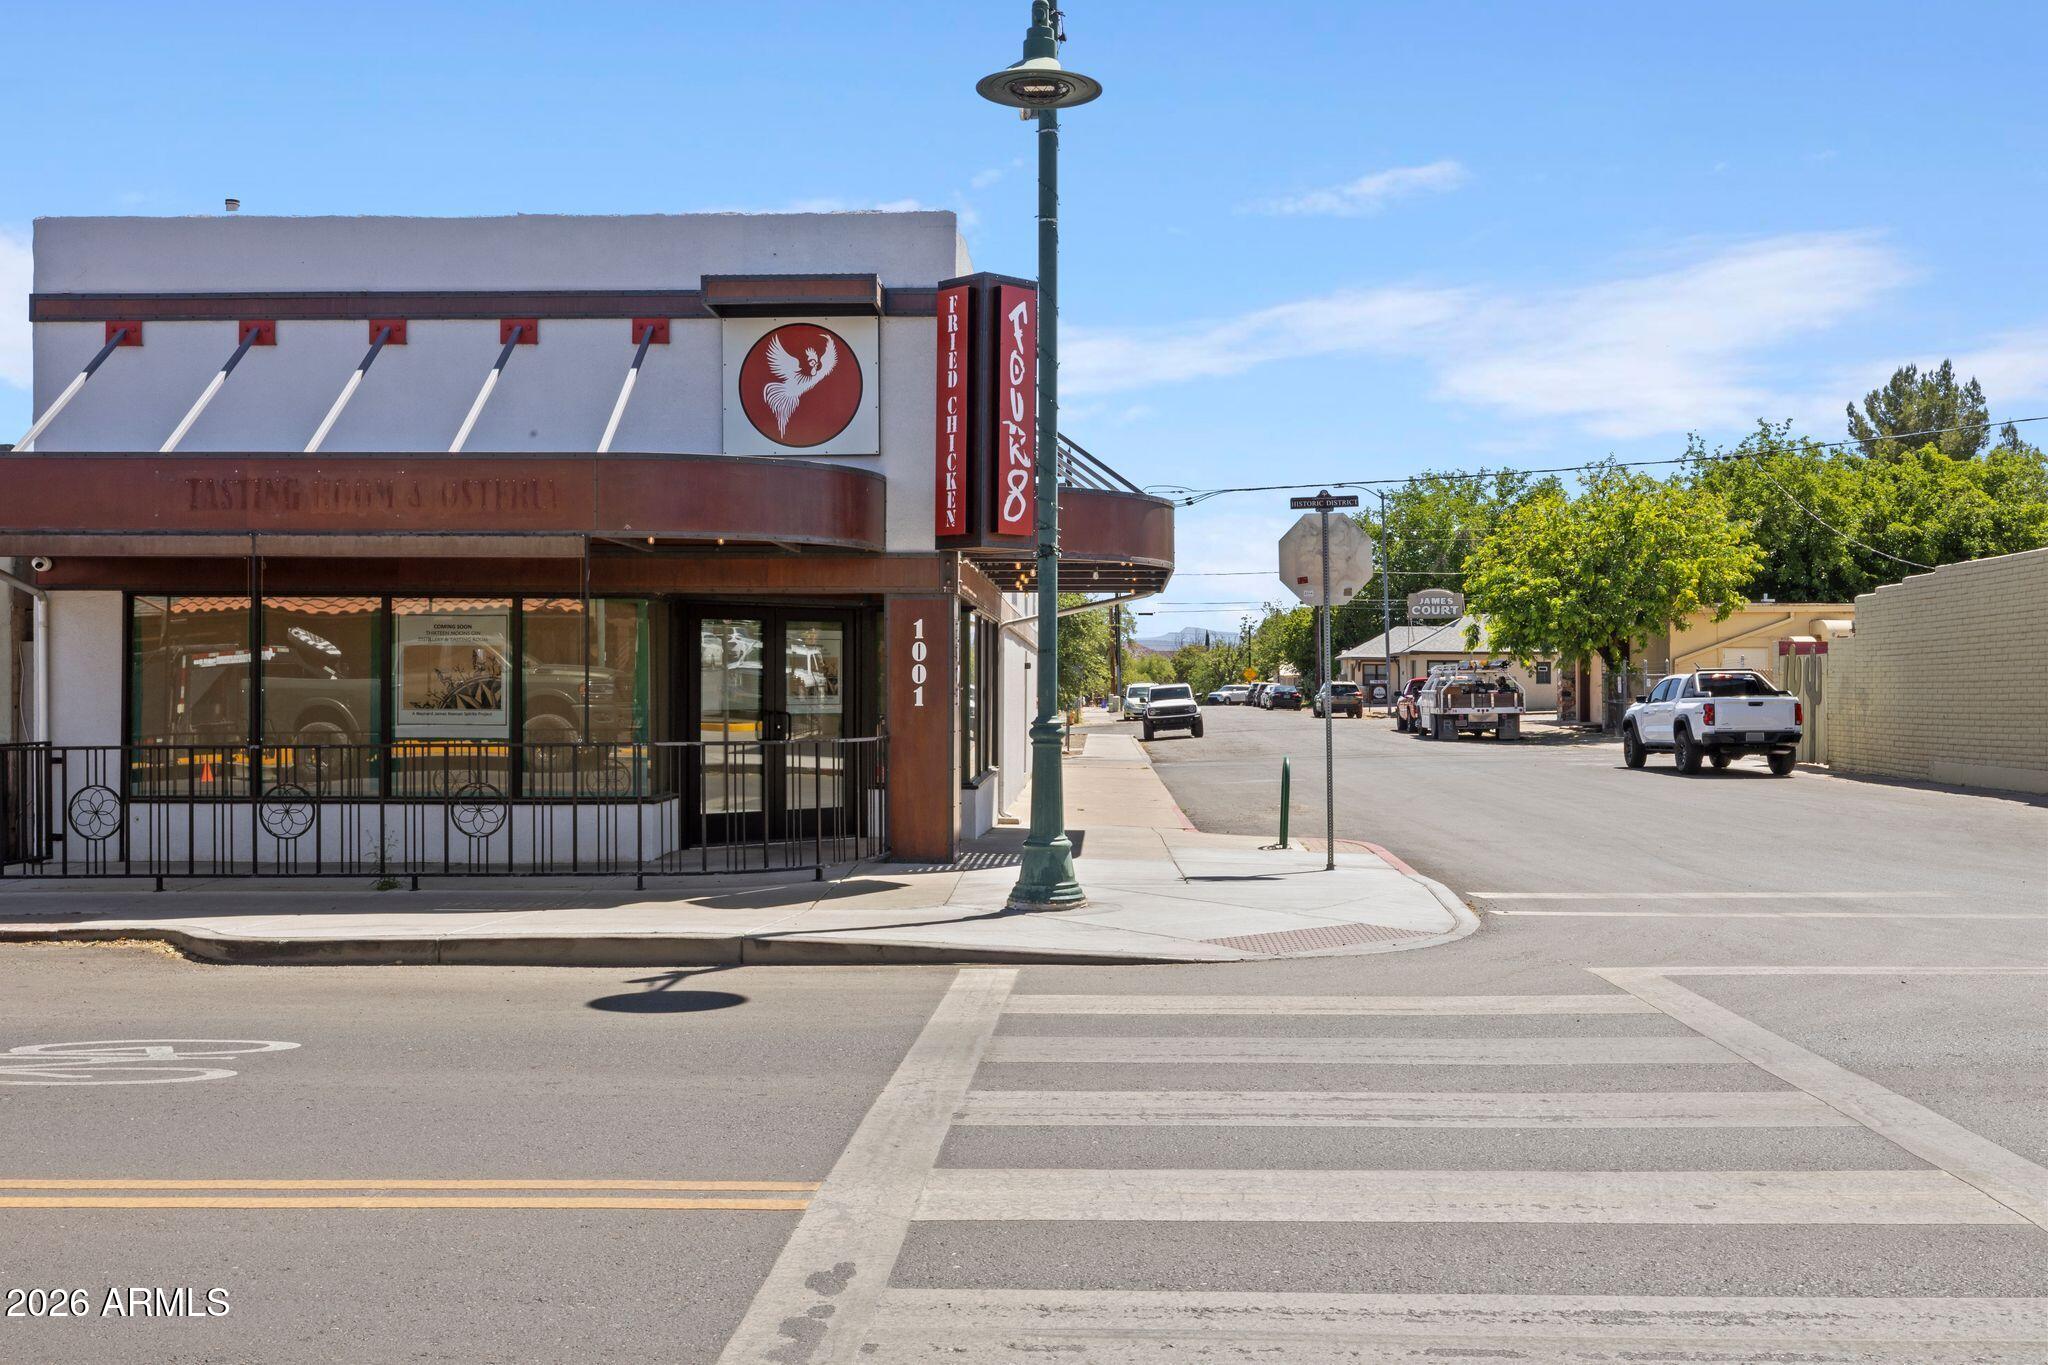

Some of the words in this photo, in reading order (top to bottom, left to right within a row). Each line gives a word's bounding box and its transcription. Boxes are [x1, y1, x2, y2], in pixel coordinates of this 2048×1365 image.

[947, 295, 959, 388] FRIED
[945, 396, 958, 528] CHICKEN
[187, 478, 300, 512] TASTING
[1291, 498, 1324, 508] HISTORIC
[1326, 498, 1357, 507] DISTRICT
[1411, 605, 1459, 615] COURT
[1419, 597, 1454, 605] JAMES
[911, 618, 927, 707] 1001
